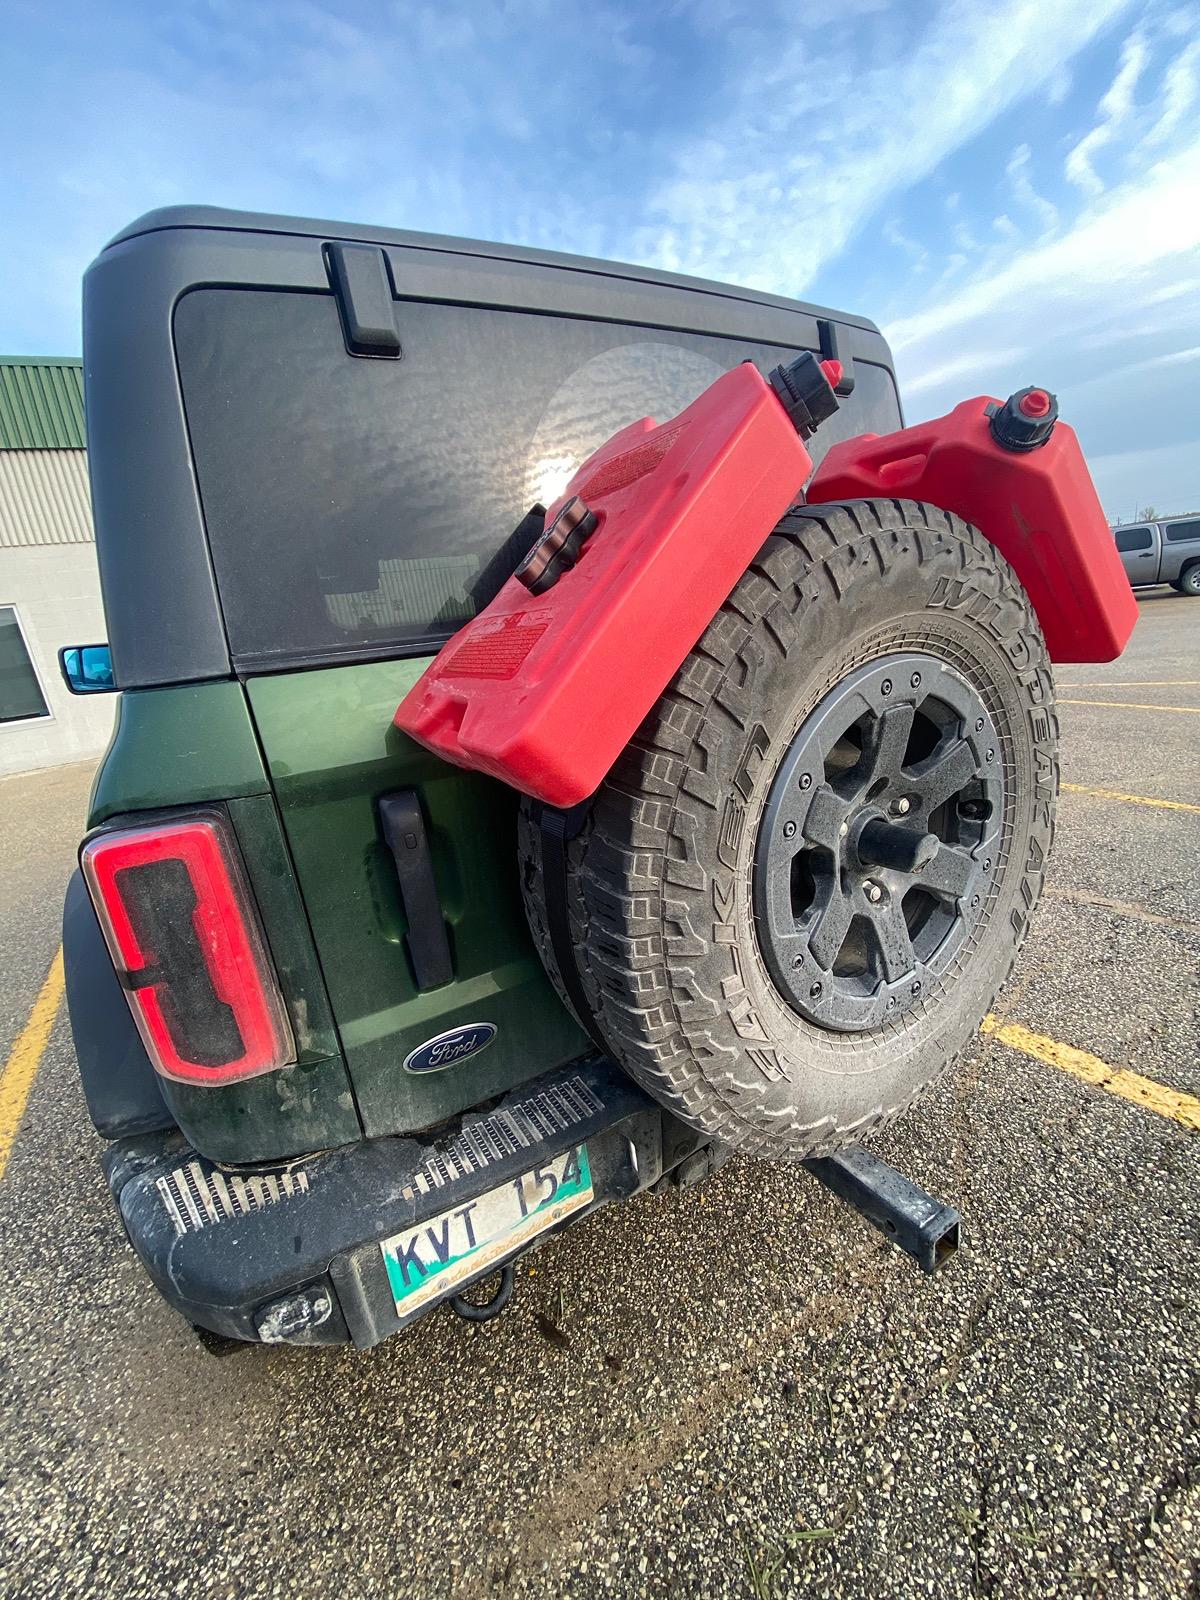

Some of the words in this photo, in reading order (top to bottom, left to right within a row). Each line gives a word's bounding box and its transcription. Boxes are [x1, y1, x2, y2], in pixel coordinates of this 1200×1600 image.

[925, 575, 1053, 828] WILDPEAK
[712, 722, 793, 1084] FALKEN
[418, 1034, 477, 1066] Ford
[395, 1201, 478, 1287] KVT
[511, 1147, 582, 1218] 154
